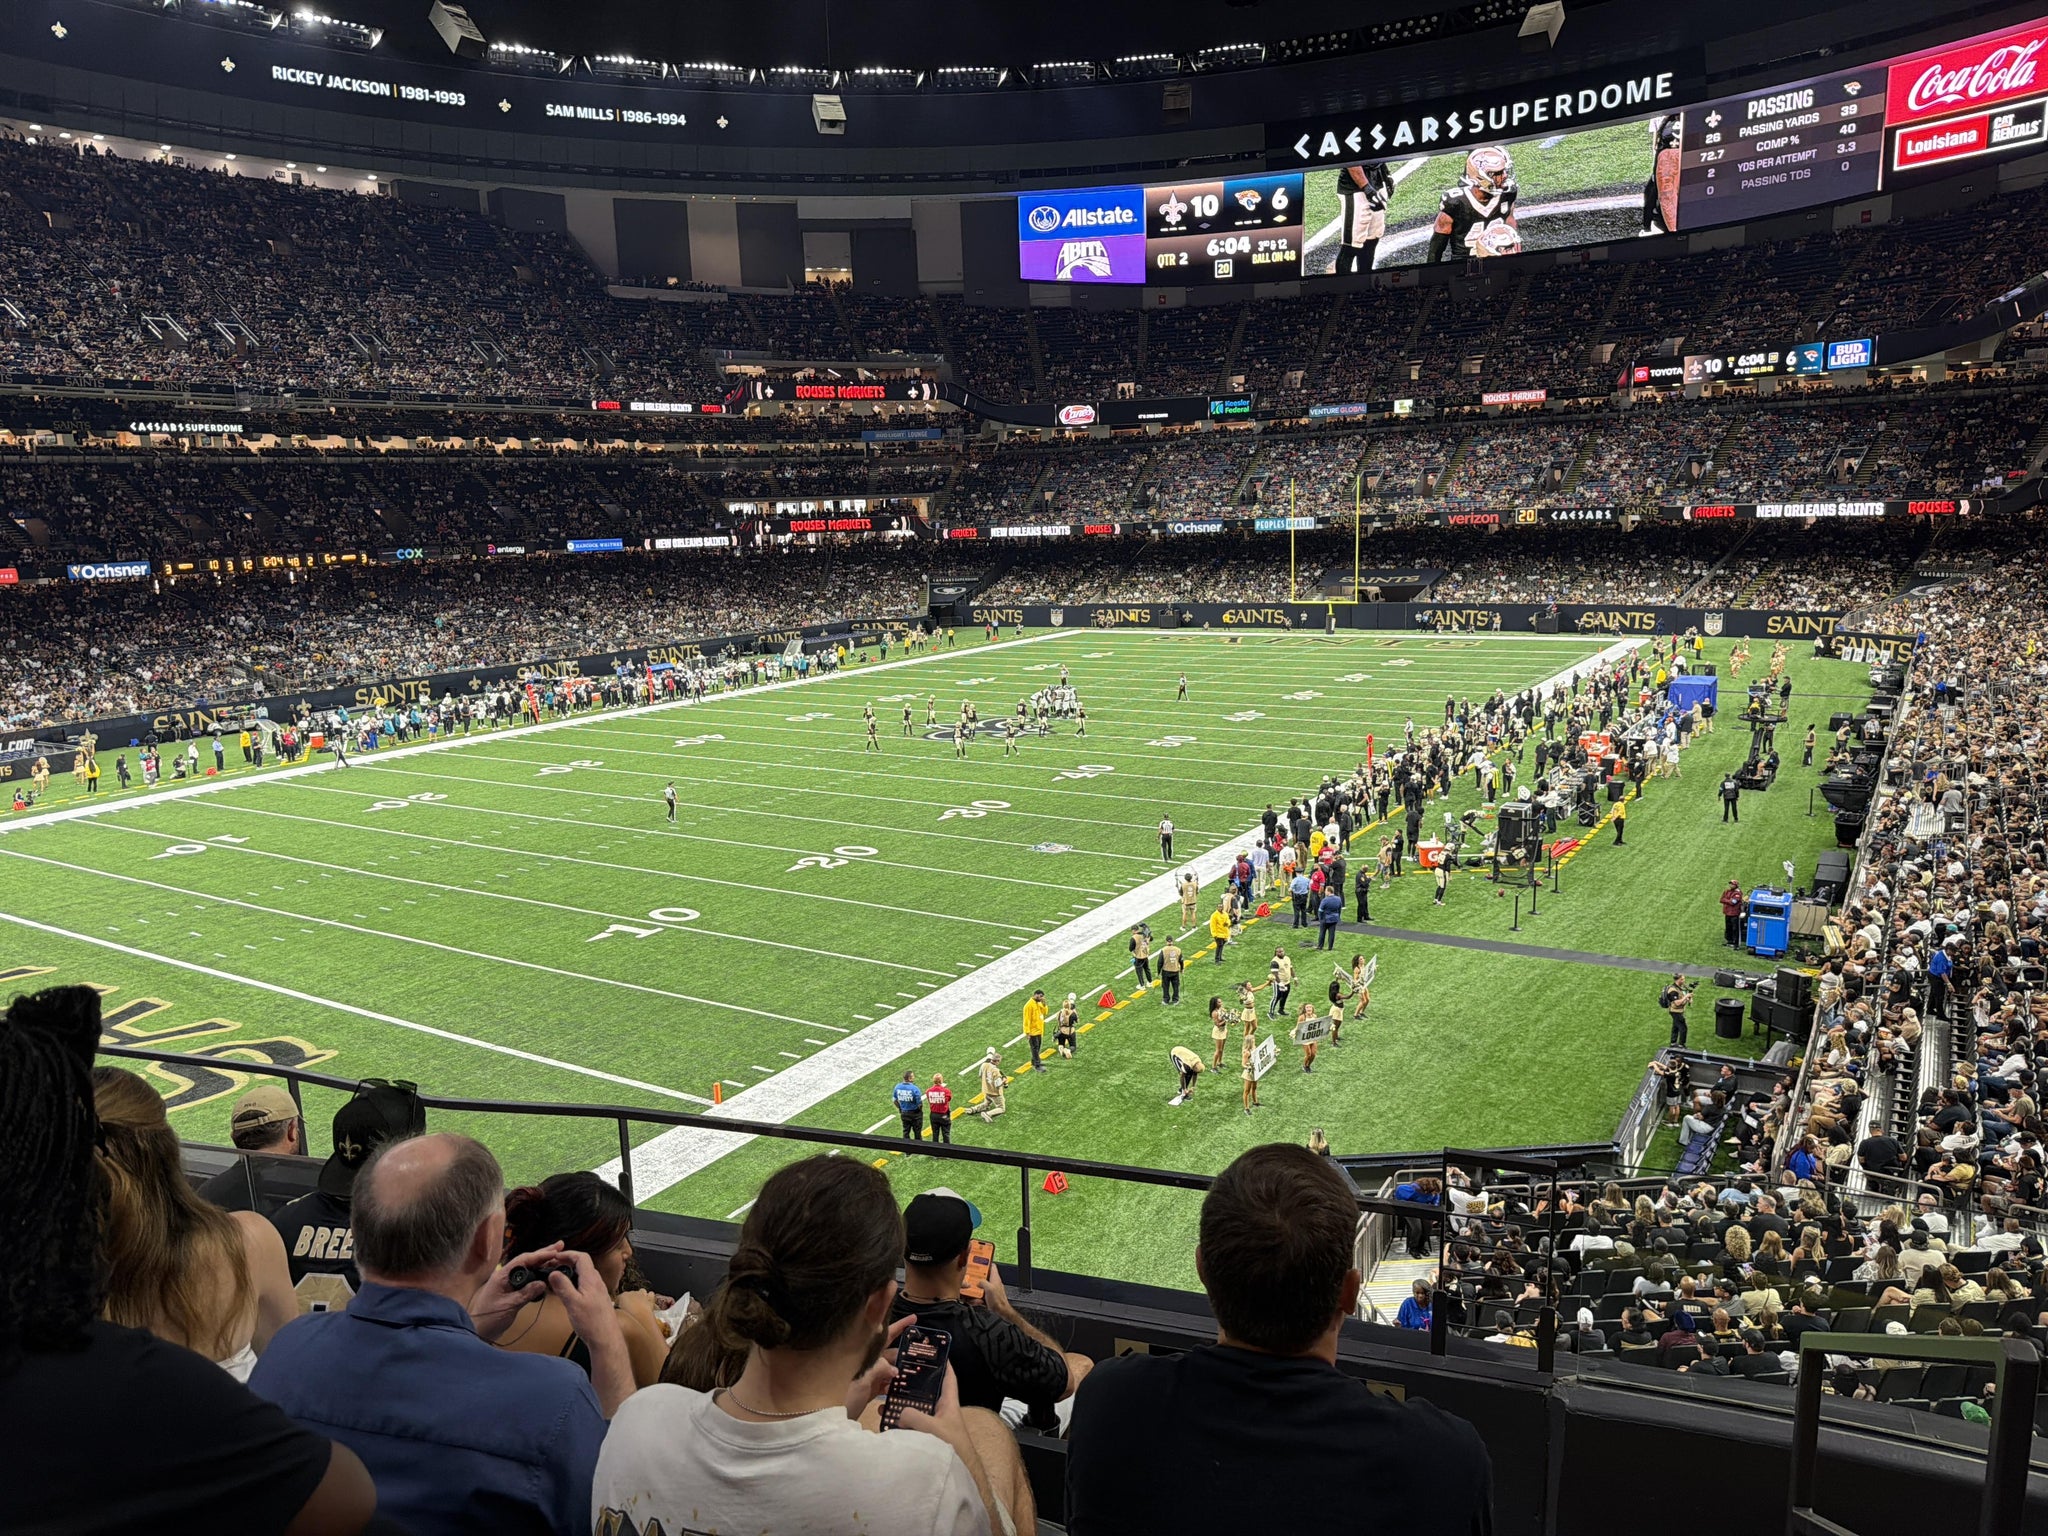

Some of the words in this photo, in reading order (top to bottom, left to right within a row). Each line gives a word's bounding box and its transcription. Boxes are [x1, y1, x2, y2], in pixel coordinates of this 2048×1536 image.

[1907, 37, 2048, 111] Coca-Cola
[272, 65, 325, 87] RICKEY
[326, 75, 391, 97] JACKSON
[399, 85, 467, 106] 1981-1993
[1747, 88, 1814, 119] PASSING
[545, 104, 575, 119] SAM
[576, 106, 615, 121] MILLS
[621, 110, 687, 126] 1986-1994
[1294, 113, 1464, 160] CAESARS
[1469, 72, 1674, 135] SUPERDOME
[1739, 120, 1784, 138] PASSING
[1784, 112, 1820, 130] YARDS
[1840, 104, 1858, 117] 39
[1992, 113, 2015, 129] CAT
[1990, 121, 2040, 143] RENTALS
[1700, 149, 1725, 162] 72.7
[1756, 137, 1788, 152] COMP
[1790, 134, 1800, 146] %
[1839, 122, 1857, 135] 40
[1906, 130, 1977, 155] Louisiana
[1707, 168, 1716, 178] 2
[1737, 159, 1756, 173] YDS
[1756, 156, 1774, 169] PER
[1774, 149, 1818, 166] ATTEMPT
[1836, 142, 1857, 155] 3.3
[1741, 172, 1787, 190] PASSING
[1789, 168, 1811, 182] TDS
[1190, 194, 1220, 217] 10
[1271, 187, 1289, 210] 6
[1157, 253, 1176, 268] QTR
[1179, 251, 1189, 266] 2
[1206, 235, 1251, 257] 6:04
[1277, 238, 1288, 250] 12
[1217, 262, 1230, 275] 20
[1252, 251, 1270, 266] BALL
[1271, 250, 1283, 263] ON
[1283, 249, 1296, 262] 48
[1835, 343, 1863, 356] BUD
[1704, 359, 1722, 373] 10
[1737, 353, 1766, 367] 6:04
[1785, 350, 1797, 366] 6
[1830, 352, 1868, 367] LIGHT
[1650, 367, 1684, 377] TOYOTA
[65, 376, 105, 388] SAINTS
[153, 380, 191, 392] SAINTS
[317, 389, 350, 400] SAINTS
[795, 385, 836, 399] ROUSES
[837, 385, 886, 399] MARKETS
[1483, 392, 1510, 403] ROUSES
[1511, 390, 1545, 401] MARKETS
[1224, 399, 1250, 407] Keesler
[1225, 406, 1250, 414] Federal
[1309, 406, 1340, 417] VENTURE
[1340, 404, 1366, 414] GLOBAL
[129, 421, 184, 432] CAESARS
[185, 423, 244, 433] SUPERDOME
[907, 430, 928, 438] LOUNGE
[1518, 509, 1535, 521] 20
[1550, 509, 1612, 521] CAESARS
[1624, 506, 1659, 516] SAINTS
[1756, 504, 1783, 518] NEW
[1783, 503, 1837, 517] ORLEANS
[1837, 502, 1885, 516] SAINTS
[1907, 501, 1956, 515] ROUSES
[1395, 512, 1426, 521] SAINTS
[1448, 510, 1500, 525] verizon
[790, 520, 826, 532] ROUSES
[827, 518, 872, 531] MARKETS
[990, 527, 1008, 538] NEW
[1008, 526, 1042, 537] ORLEANS
[1042, 525, 1071, 536] SAINTS
[1084, 524, 1113, 535] ROUSES
[1174, 521, 1222, 533] Ochsner
[1256, 520, 1285, 530] PEOPLES
[497, 545, 525, 554] entergy
[655, 539, 672, 549] NEW
[672, 537, 703, 548] ORLEANS
[703, 536, 729, 547] SAINTS
[81, 564, 147, 579] Ochsner
[165, 564, 172, 576] 3
[209, 560, 219, 571] 10
[227, 561, 234, 572] 3
[243, 560, 253, 571] 12
[1338, 575, 1421, 584] SAINTS
[973, 609, 1024, 623] SAINTS
[1097, 609, 1151, 624] SAINTS
[1226, 609, 1284, 625] SAINTS
[1582, 611, 1656, 631] SAINTS
[851, 621, 909, 638] SAINTS
[1767, 616, 1840, 635] SAINT
[649, 644, 702, 664] SAINTS
[516, 660, 580, 681] SAINTS
[355, 680, 432, 707] SAINTS
[1143, 735, 1198, 748] 50
[1060, 764, 1115, 779] 40
[373, 792, 449, 809] 20
[943, 800, 1011, 818] 30
[165, 834, 251, 855] 10
[796, 845, 879, 869] 20
[1427, 850, 1439, 862] G
[604, 907, 701, 939] 10
[1307, 1020, 1323, 1031] GET
[1301, 1028, 1325, 1041] LOUD!
[1258, 1044, 1268, 1060] GET
[929, 1096, 946, 1104] SAFETY
[1052, 1171, 1065, 1191] G
[292, 1225, 354, 1259] BREE
